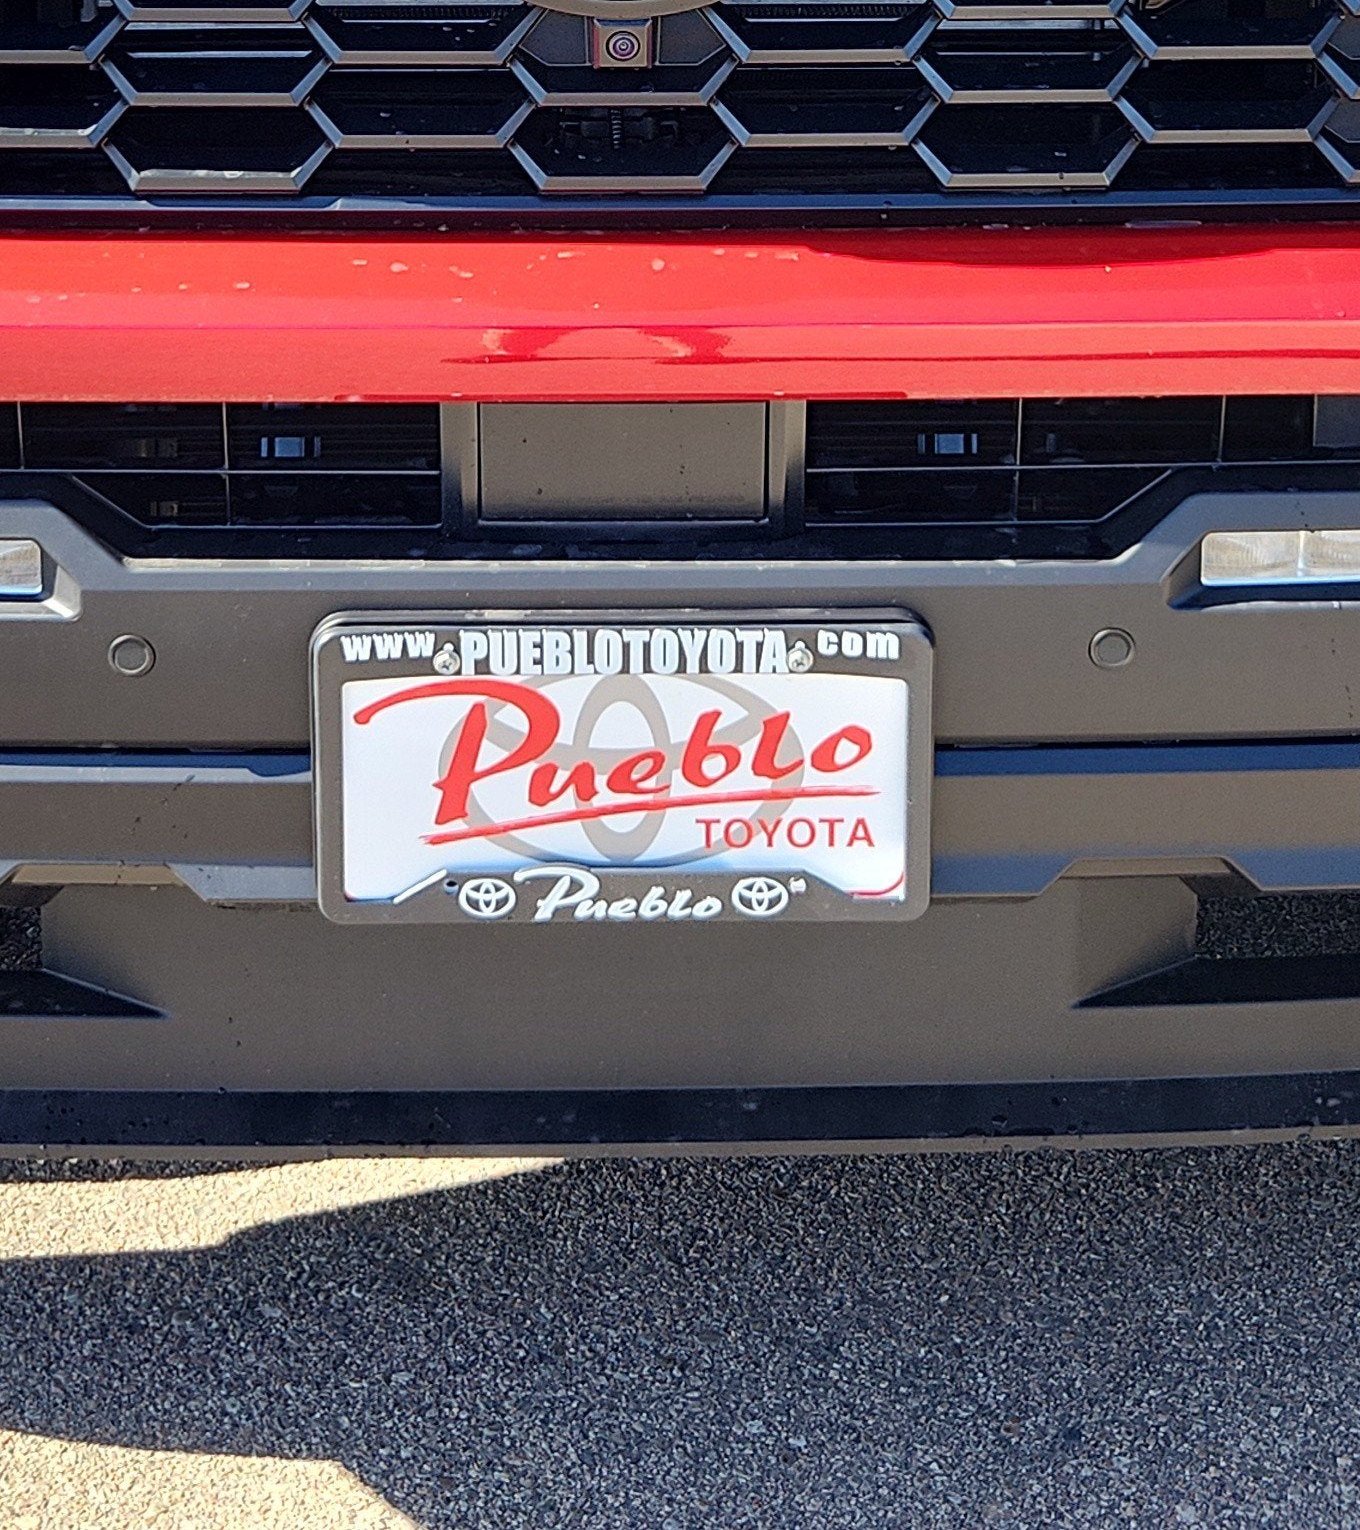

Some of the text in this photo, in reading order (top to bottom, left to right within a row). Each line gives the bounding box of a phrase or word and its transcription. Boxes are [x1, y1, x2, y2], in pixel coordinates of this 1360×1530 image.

[354, 680, 873, 826] Pueblo
[695, 817, 875, 849] TOYOTA
[514, 867, 723, 922] Pueblo
